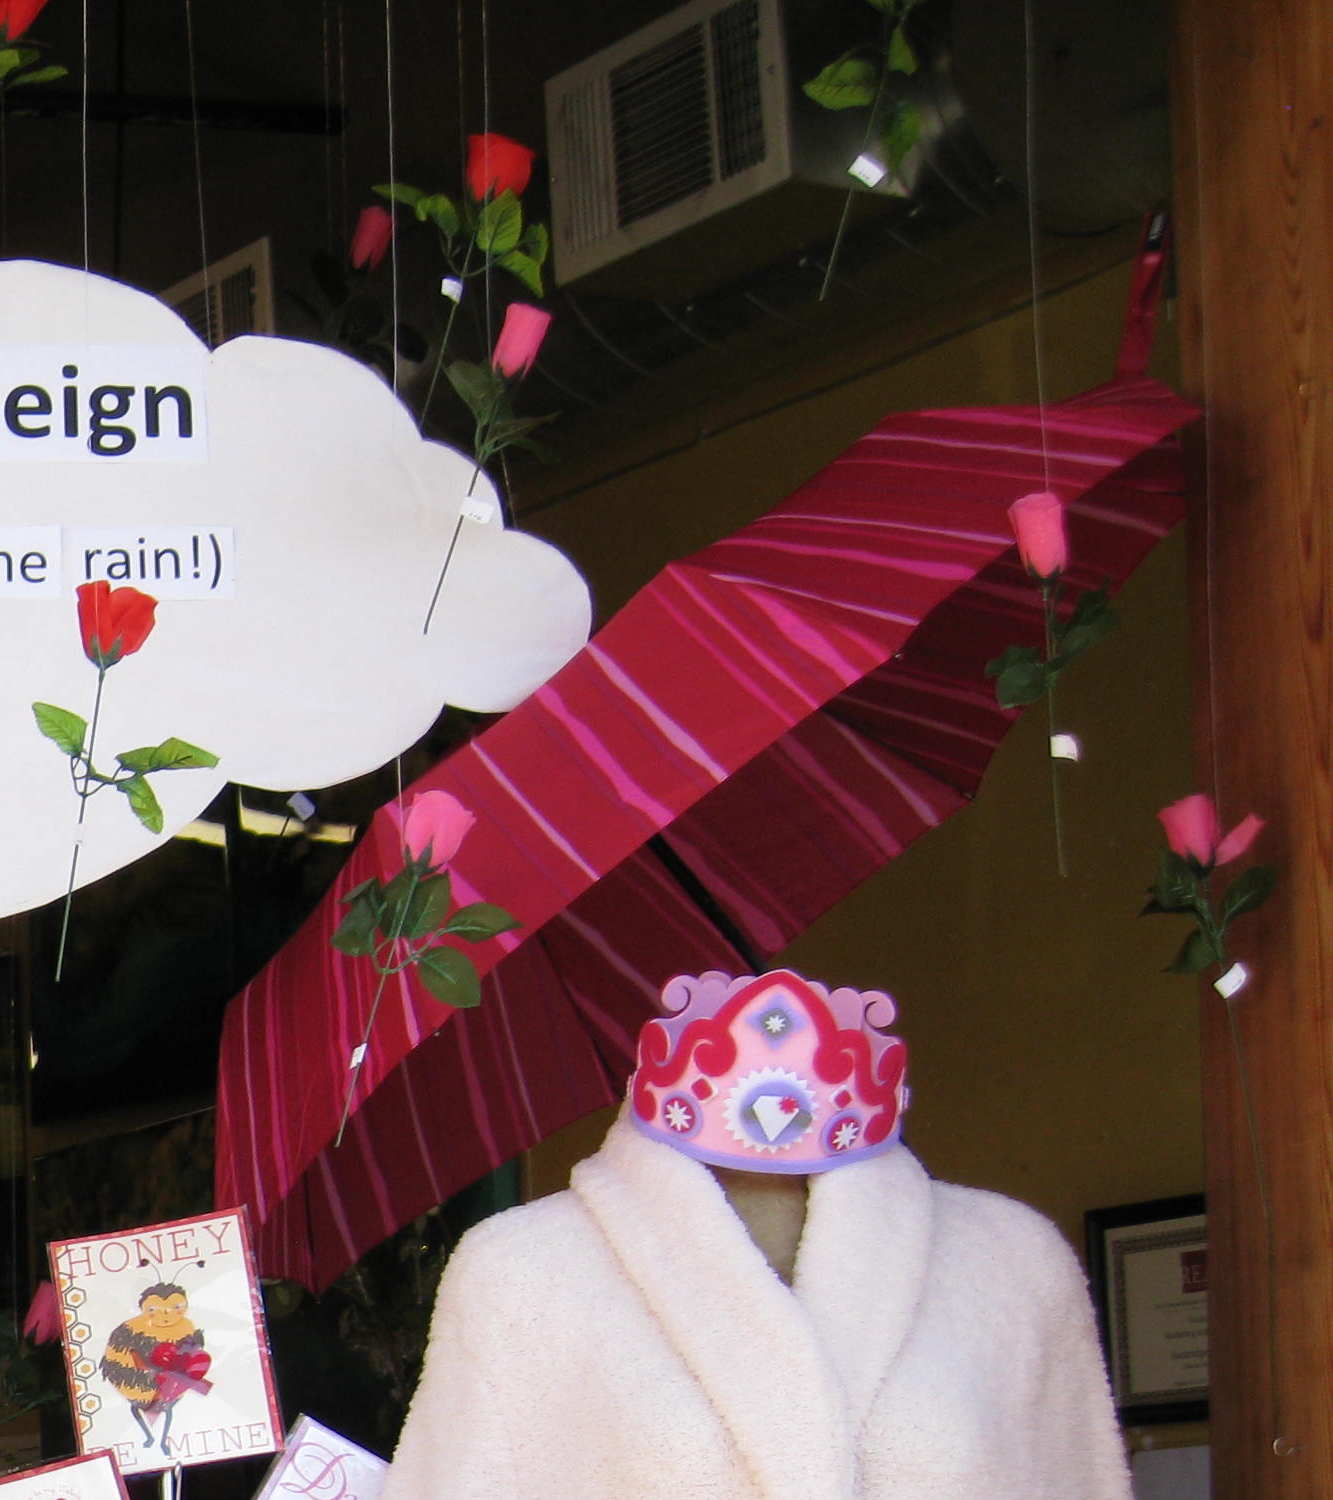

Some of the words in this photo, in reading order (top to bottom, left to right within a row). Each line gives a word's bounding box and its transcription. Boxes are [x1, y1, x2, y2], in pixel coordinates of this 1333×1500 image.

[82, 539, 223, 590] rain!)
[67, 1222, 232, 1279] HONEY
[166, 1422, 269, 1460] MINE
